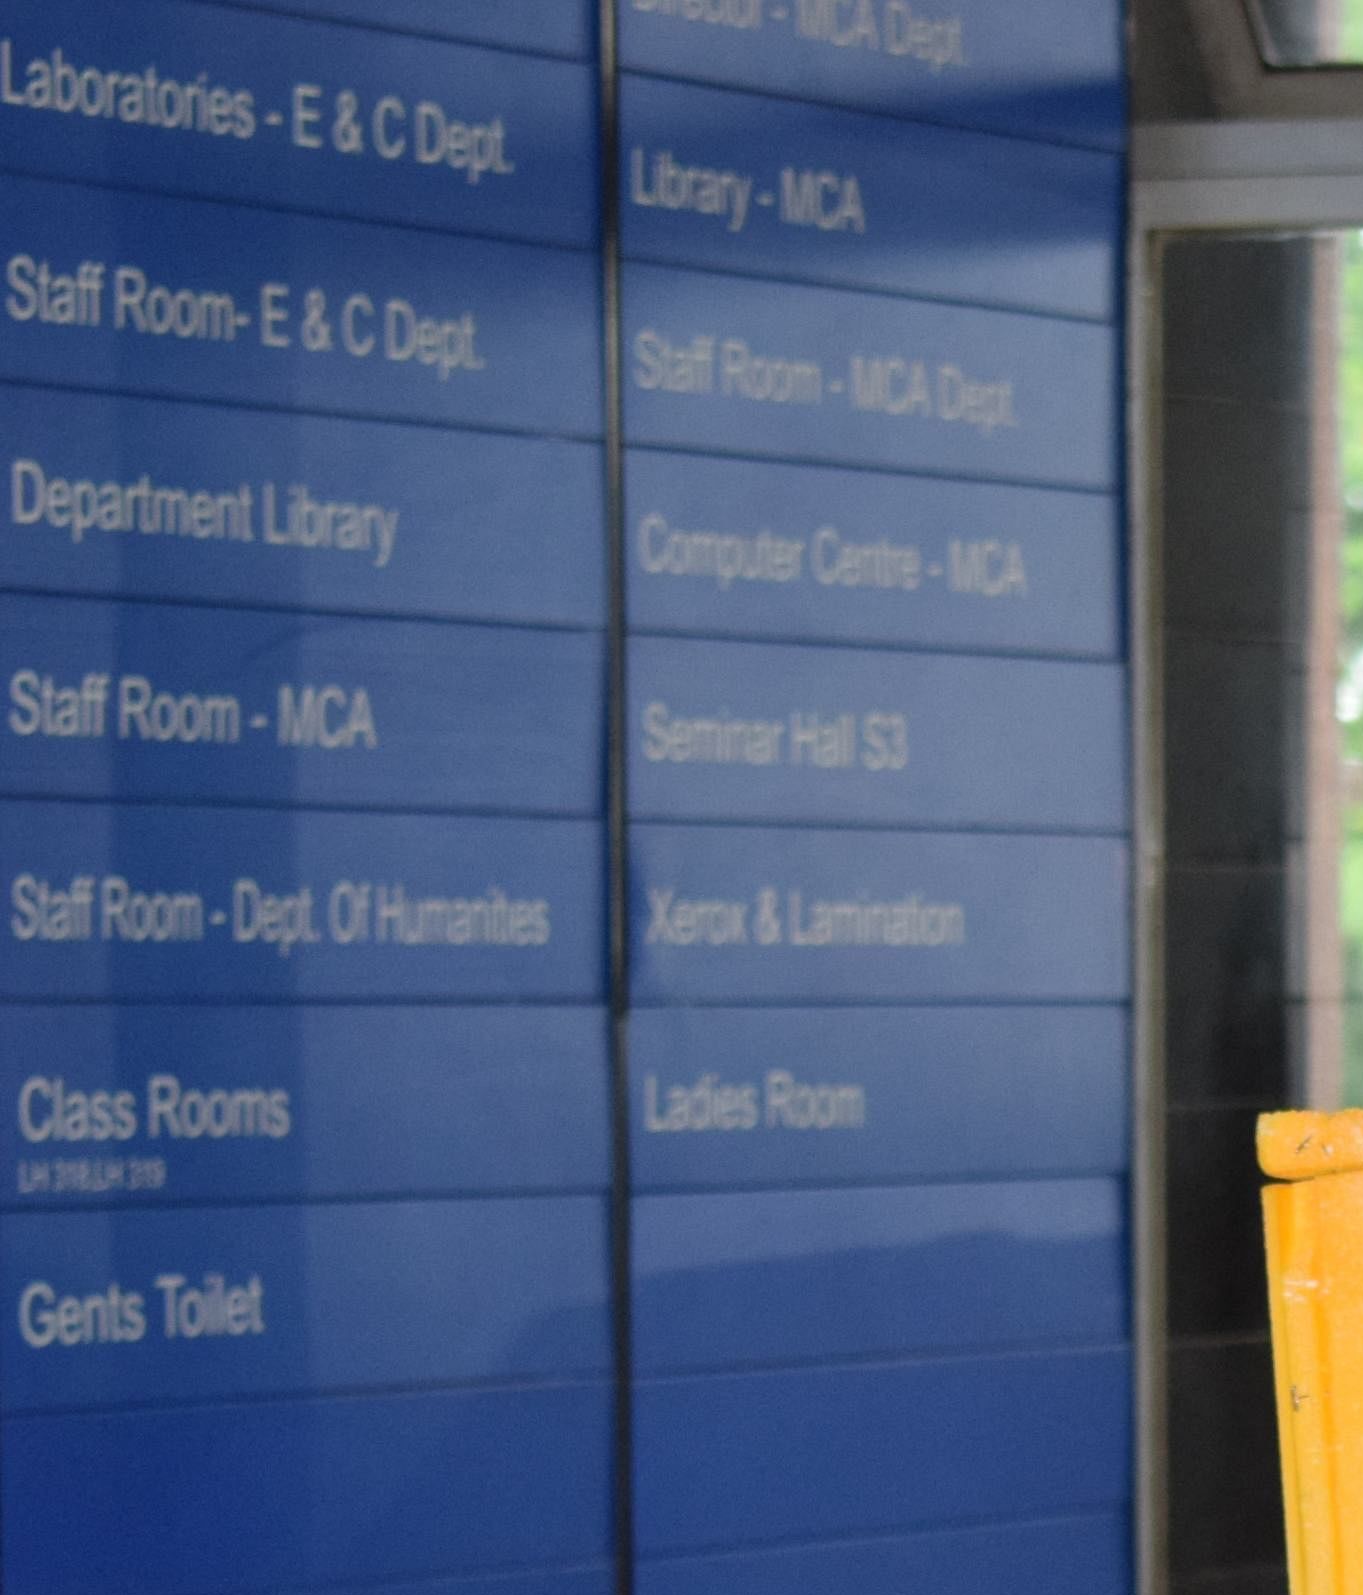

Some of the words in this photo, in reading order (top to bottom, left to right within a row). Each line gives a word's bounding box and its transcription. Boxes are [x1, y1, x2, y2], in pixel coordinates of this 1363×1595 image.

[1, 39, 255, 138] Laboratories
[293, 84, 322, 148] E
[333, 90, 363, 154] &
[372, 96, 405, 159] C
[415, 104, 514, 184] Dept.
[631, 147, 751, 233] Library
[780, 166, 867, 234] MCA
[7, 254, 104, 326] Staff
[261, 283, 291, 348] E
[303, 288, 334, 352] &
[342, 294, 375, 357] C
[385, 299, 486, 382] Dept.
[634, 328, 714, 395] Staff
[721, 338, 823, 404] Room
[851, 354, 932, 417] MCA
[11, 459, 254, 544] Department
[262, 482, 400, 568] Library
[638, 511, 805, 591] Computer
[811, 525, 922, 592] Centre
[948, 537, 1029, 598] MCA
[9, 669, 109, 738] Staff
[118, 675, 240, 743] Room
[277, 683, 378, 748] MCA
[641, 701, 786, 766] Seminar
[790, 709, 857, 770] Hall
[10, 872, 95, 941] Staff
[103, 876, 202, 941] Room
[233, 878, 320, 958] Dept.
[329, 880, 373, 943] Of
[377, 880, 550, 946] Humanities
[645, 885, 748, 946] Xerox
[755, 884, 782, 946] &
[788, 890, 967, 947] Lamination
[18, 1075, 137, 1142] Class
[147, 1074, 291, 1140] Rooms
[643, 1072, 758, 1133] Ladies
[763, 1066, 866, 1131] Room
[19, 1281, 146, 1349] Gents
[157, 1273, 266, 1339] Toilet
